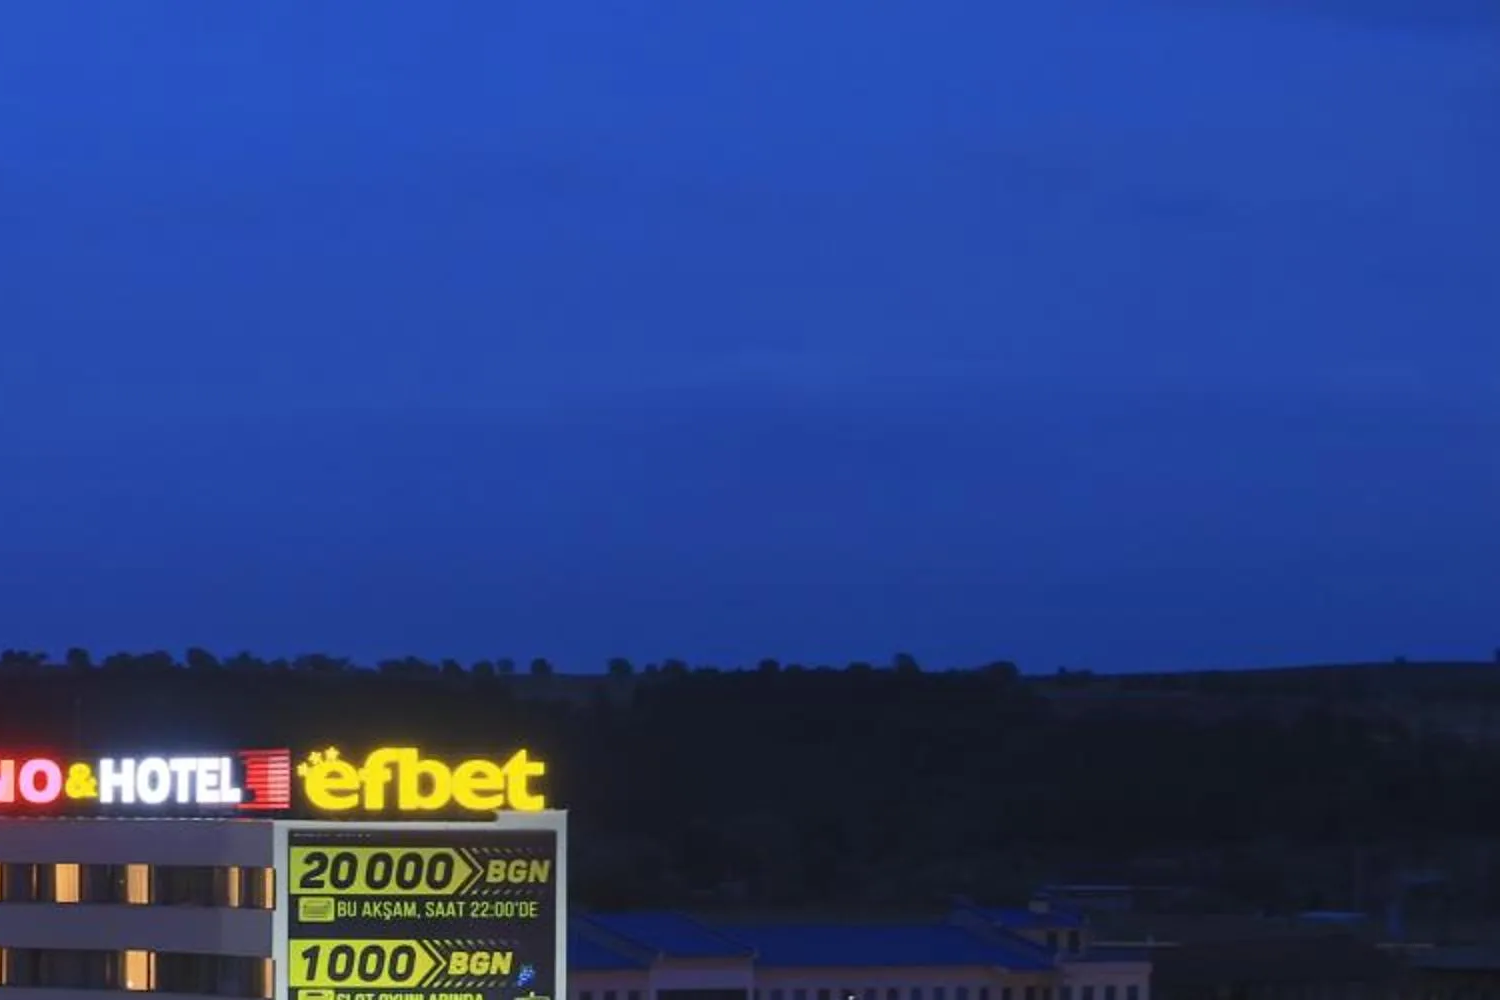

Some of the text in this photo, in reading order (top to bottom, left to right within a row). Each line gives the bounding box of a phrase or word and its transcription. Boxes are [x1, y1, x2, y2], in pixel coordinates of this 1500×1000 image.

[304, 747, 545, 811] efbet
[485, 859, 551, 884] BGN
[337, 902, 358, 917] BU
[425, 902, 466, 917] SAAT
[447, 951, 513, 975] BGN
